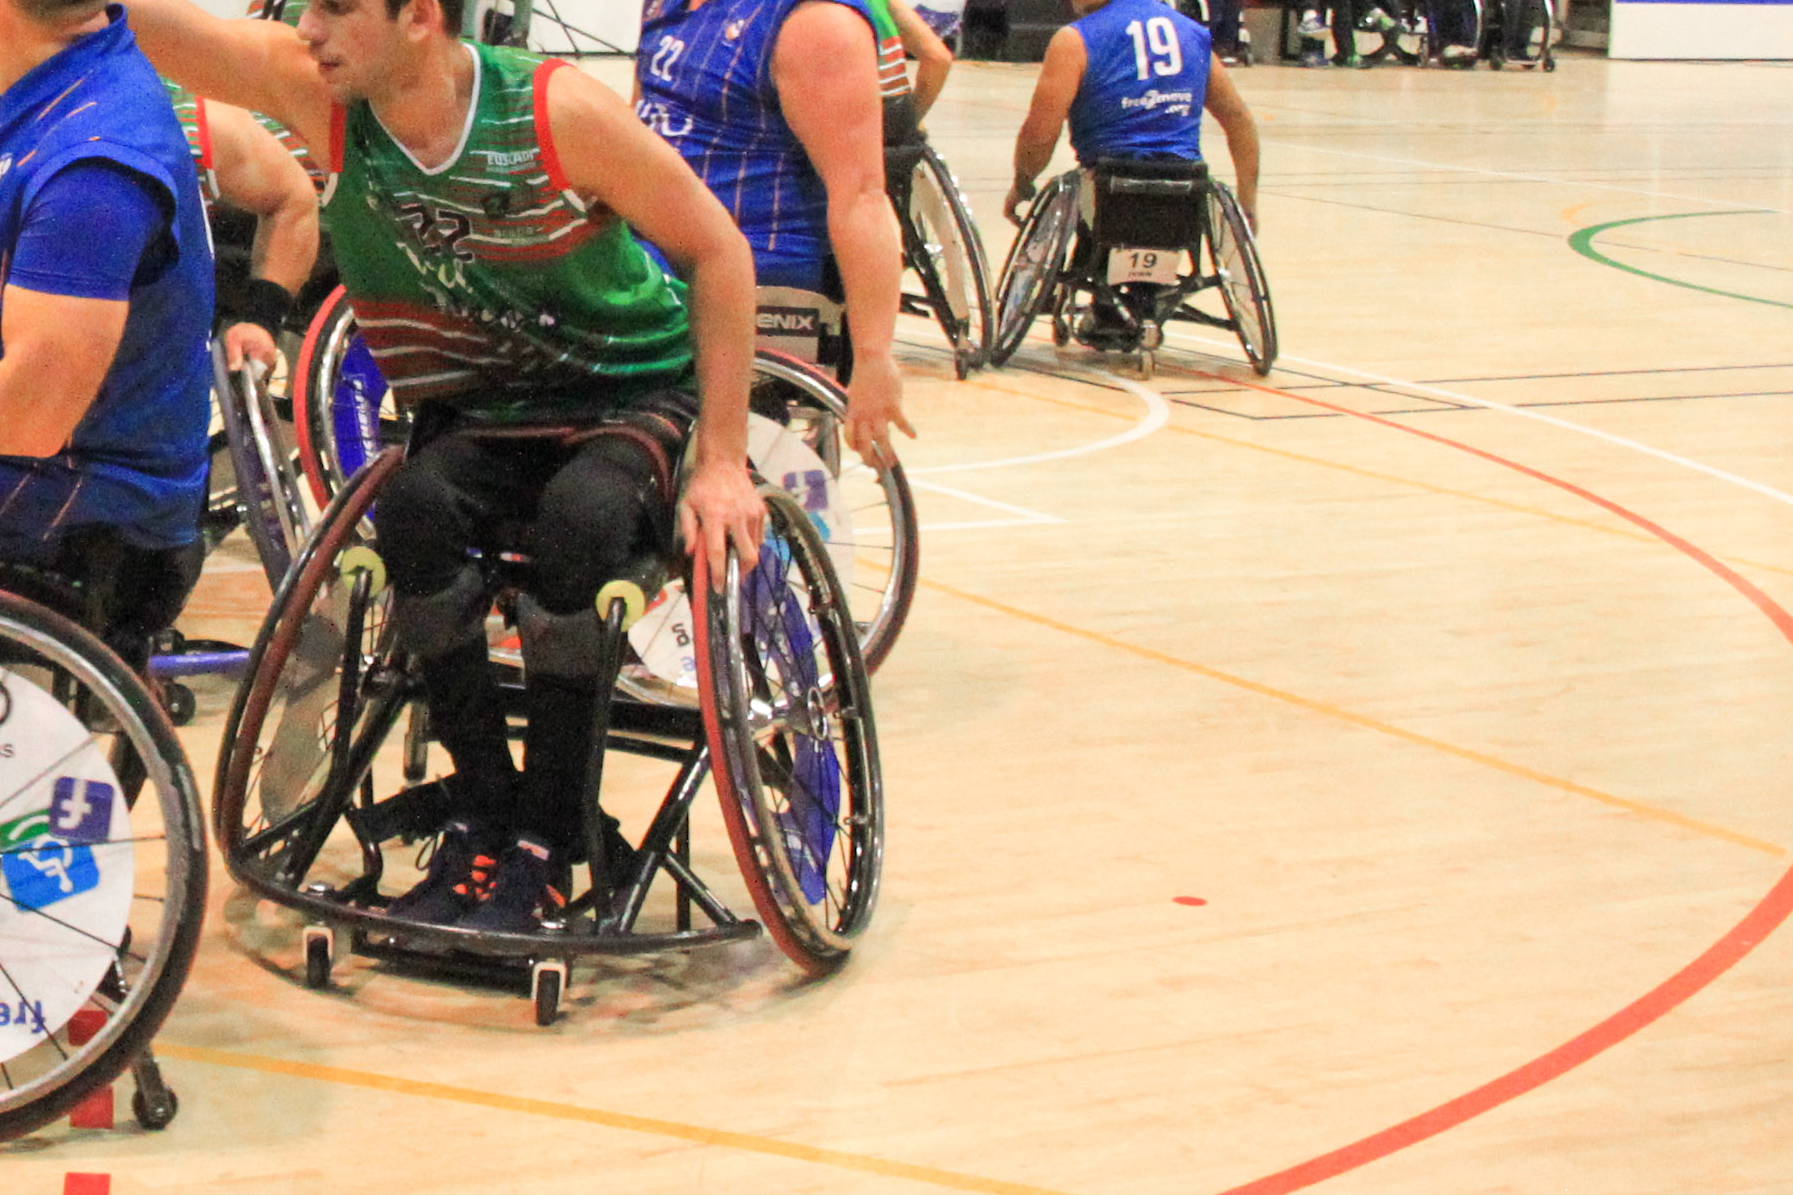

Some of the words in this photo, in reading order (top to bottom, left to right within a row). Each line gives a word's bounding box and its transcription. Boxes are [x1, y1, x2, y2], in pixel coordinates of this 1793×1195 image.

[650, 35, 685, 82] 22
[1126, 16, 1184, 81] 19
[1130, 252, 1157, 268] 19
